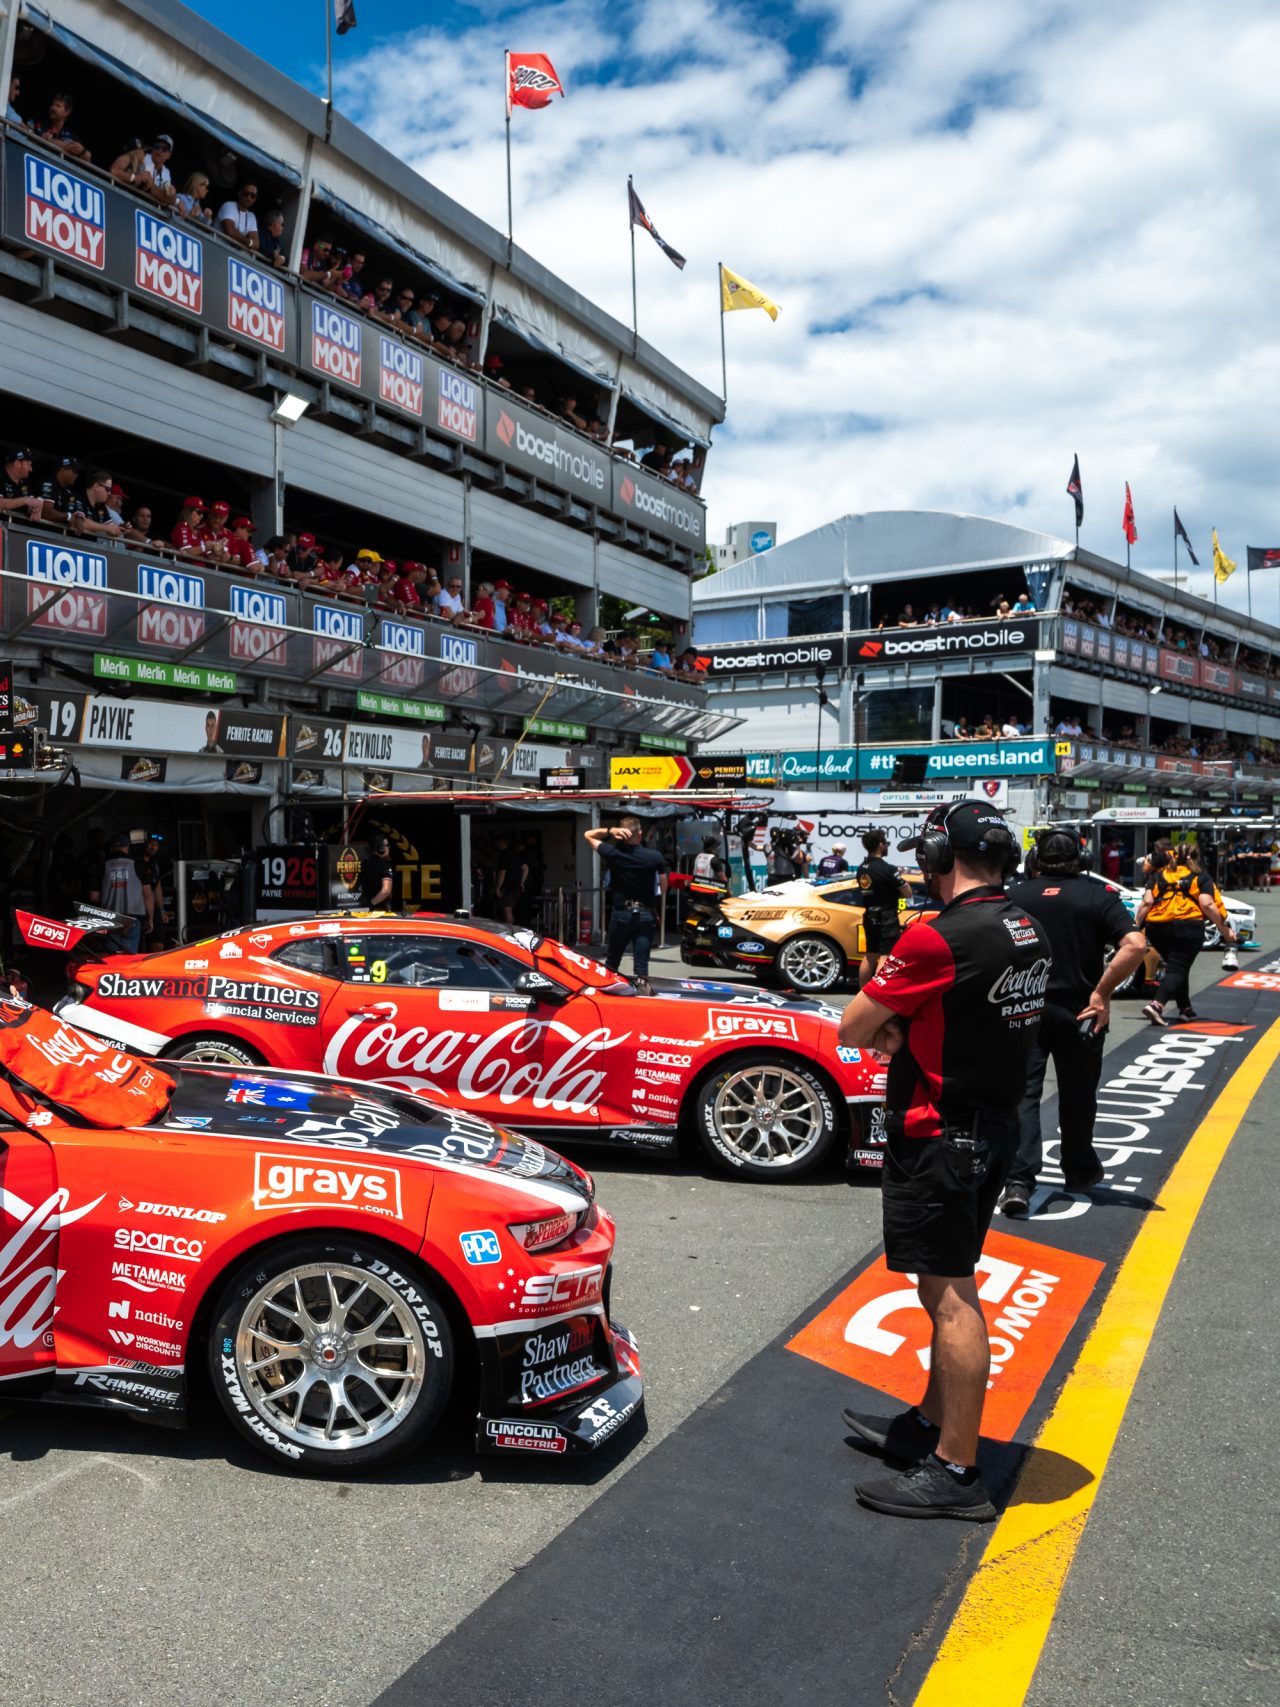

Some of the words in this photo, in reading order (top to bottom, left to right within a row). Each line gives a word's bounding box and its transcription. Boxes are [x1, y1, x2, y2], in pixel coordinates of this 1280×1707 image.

[28, 161, 101, 225] LIQUI
[29, 200, 103, 262] MOLY
[138, 214, 199, 273] LIQUI
[138, 252, 200, 307] MOLY
[231, 261, 282, 314] LIQUI
[230, 301, 284, 347] MOLY
[314, 305, 359, 352] LIQUI
[313, 338, 360, 383] MOLY
[382, 339, 420, 382] LIQUI
[381, 369, 422, 412] MOLY
[440, 372, 474, 410] LIQUI
[439, 400, 476, 437] MOLY
[32, 546, 105, 588] LIQUI
[142, 570, 202, 608] LIQUI
[32, 587, 104, 631] MOLY
[234, 591, 284, 625] LIQUI
[140, 607, 204, 646] MOLY
[317, 608, 361, 641] LIQUI
[233, 624, 285, 661] MOLY
[384, 625, 422, 656] LIQUI
[442, 638, 476, 666] LIQUI
[316, 639, 361, 675] MOLY
[383, 653, 423, 684] MOLY
[100, 659, 130, 676] Merlin
[137, 663, 166, 681] Merlin
[174, 667, 201, 685] Merlin
[207, 672, 234, 689] Merlin
[441, 665, 477, 695] MOLY
[50, 700, 76, 737] 19
[89, 705, 135, 741] PAYNE
[424, 703, 444, 717] Merlin
[226, 725, 252, 742] PENRITE
[252, 726, 273, 744] RACING
[323, 728, 342, 757] 26
[348, 731, 393, 760] REYNOLDS
[514, 748, 538, 771] PERCAT
[614, 766, 641, 775] JAX
[714, 766, 745, 775] PENRITE
[783, 754, 853, 776] Queensland
[916, 793, 936, 801] Mobil
[1166, 808, 1200, 817] TRADIE
[261, 857, 287, 886] 19
[336, 861, 362, 873] PENRITE
[261, 888, 283, 898] PAYNE
[78, 904, 116, 919] SUPERCHEAP
[32, 924, 67, 941] grays
[741, 942, 762, 952] Ford
[1009, 928, 1036, 940] Partners
[372, 960, 386, 983] 9
[988, 957, 1053, 1004] Coca-Cola
[265, 1006, 317, 1025] Services
[1001, 998, 1045, 1017] RACING
[716, 1014, 788, 1034] grays
[1008, 1018, 1020, 1030] by
[195, 1040, 224, 1050] SPORT
[649, 1035, 704, 1048] DUNLOP
[322, 1003, 632, 1114] Coca-Cola
[637, 1050, 692, 1066] sparco
[634, 1067, 681, 1082] METAMARK
[648, 1093, 678, 1105] natiive
[801, 1071, 833, 1132] DUNLOP
[608, 1130, 674, 1144] RAMPAGE
[704, 1105, 719, 1140] MAXX
[713, 1138, 744, 1166] SPORT
[269, 1164, 387, 1201] grays
[134, 1201, 227, 1224] DUNLOP
[114, 1228, 203, 1257] sparco
[466, 1232, 501, 1262] PPG
[111, 1261, 187, 1288] METAMARK
[521, 1263, 603, 1305] SCTR
[134, 1309, 184, 1330] natiive
[366, 1259, 442, 1357] DUNLOP
[993, 1269, 1060, 1341] NOW
[135, 1341, 181, 1358] DISCOUNTS
[136, 1334, 182, 1351] WORKWEAR
[134, 1360, 180, 1379] Repco
[221, 1353, 251, 1412] MAXX
[521, 1354, 595, 1404] Partners
[74, 1371, 180, 1401] RAMPAGE
[578, 1397, 616, 1428] XF
[243, 1414, 305, 1459] SPORT
[490, 1423, 553, 1438] LINCOLN
[504, 1437, 558, 1449] ELECTRIC
